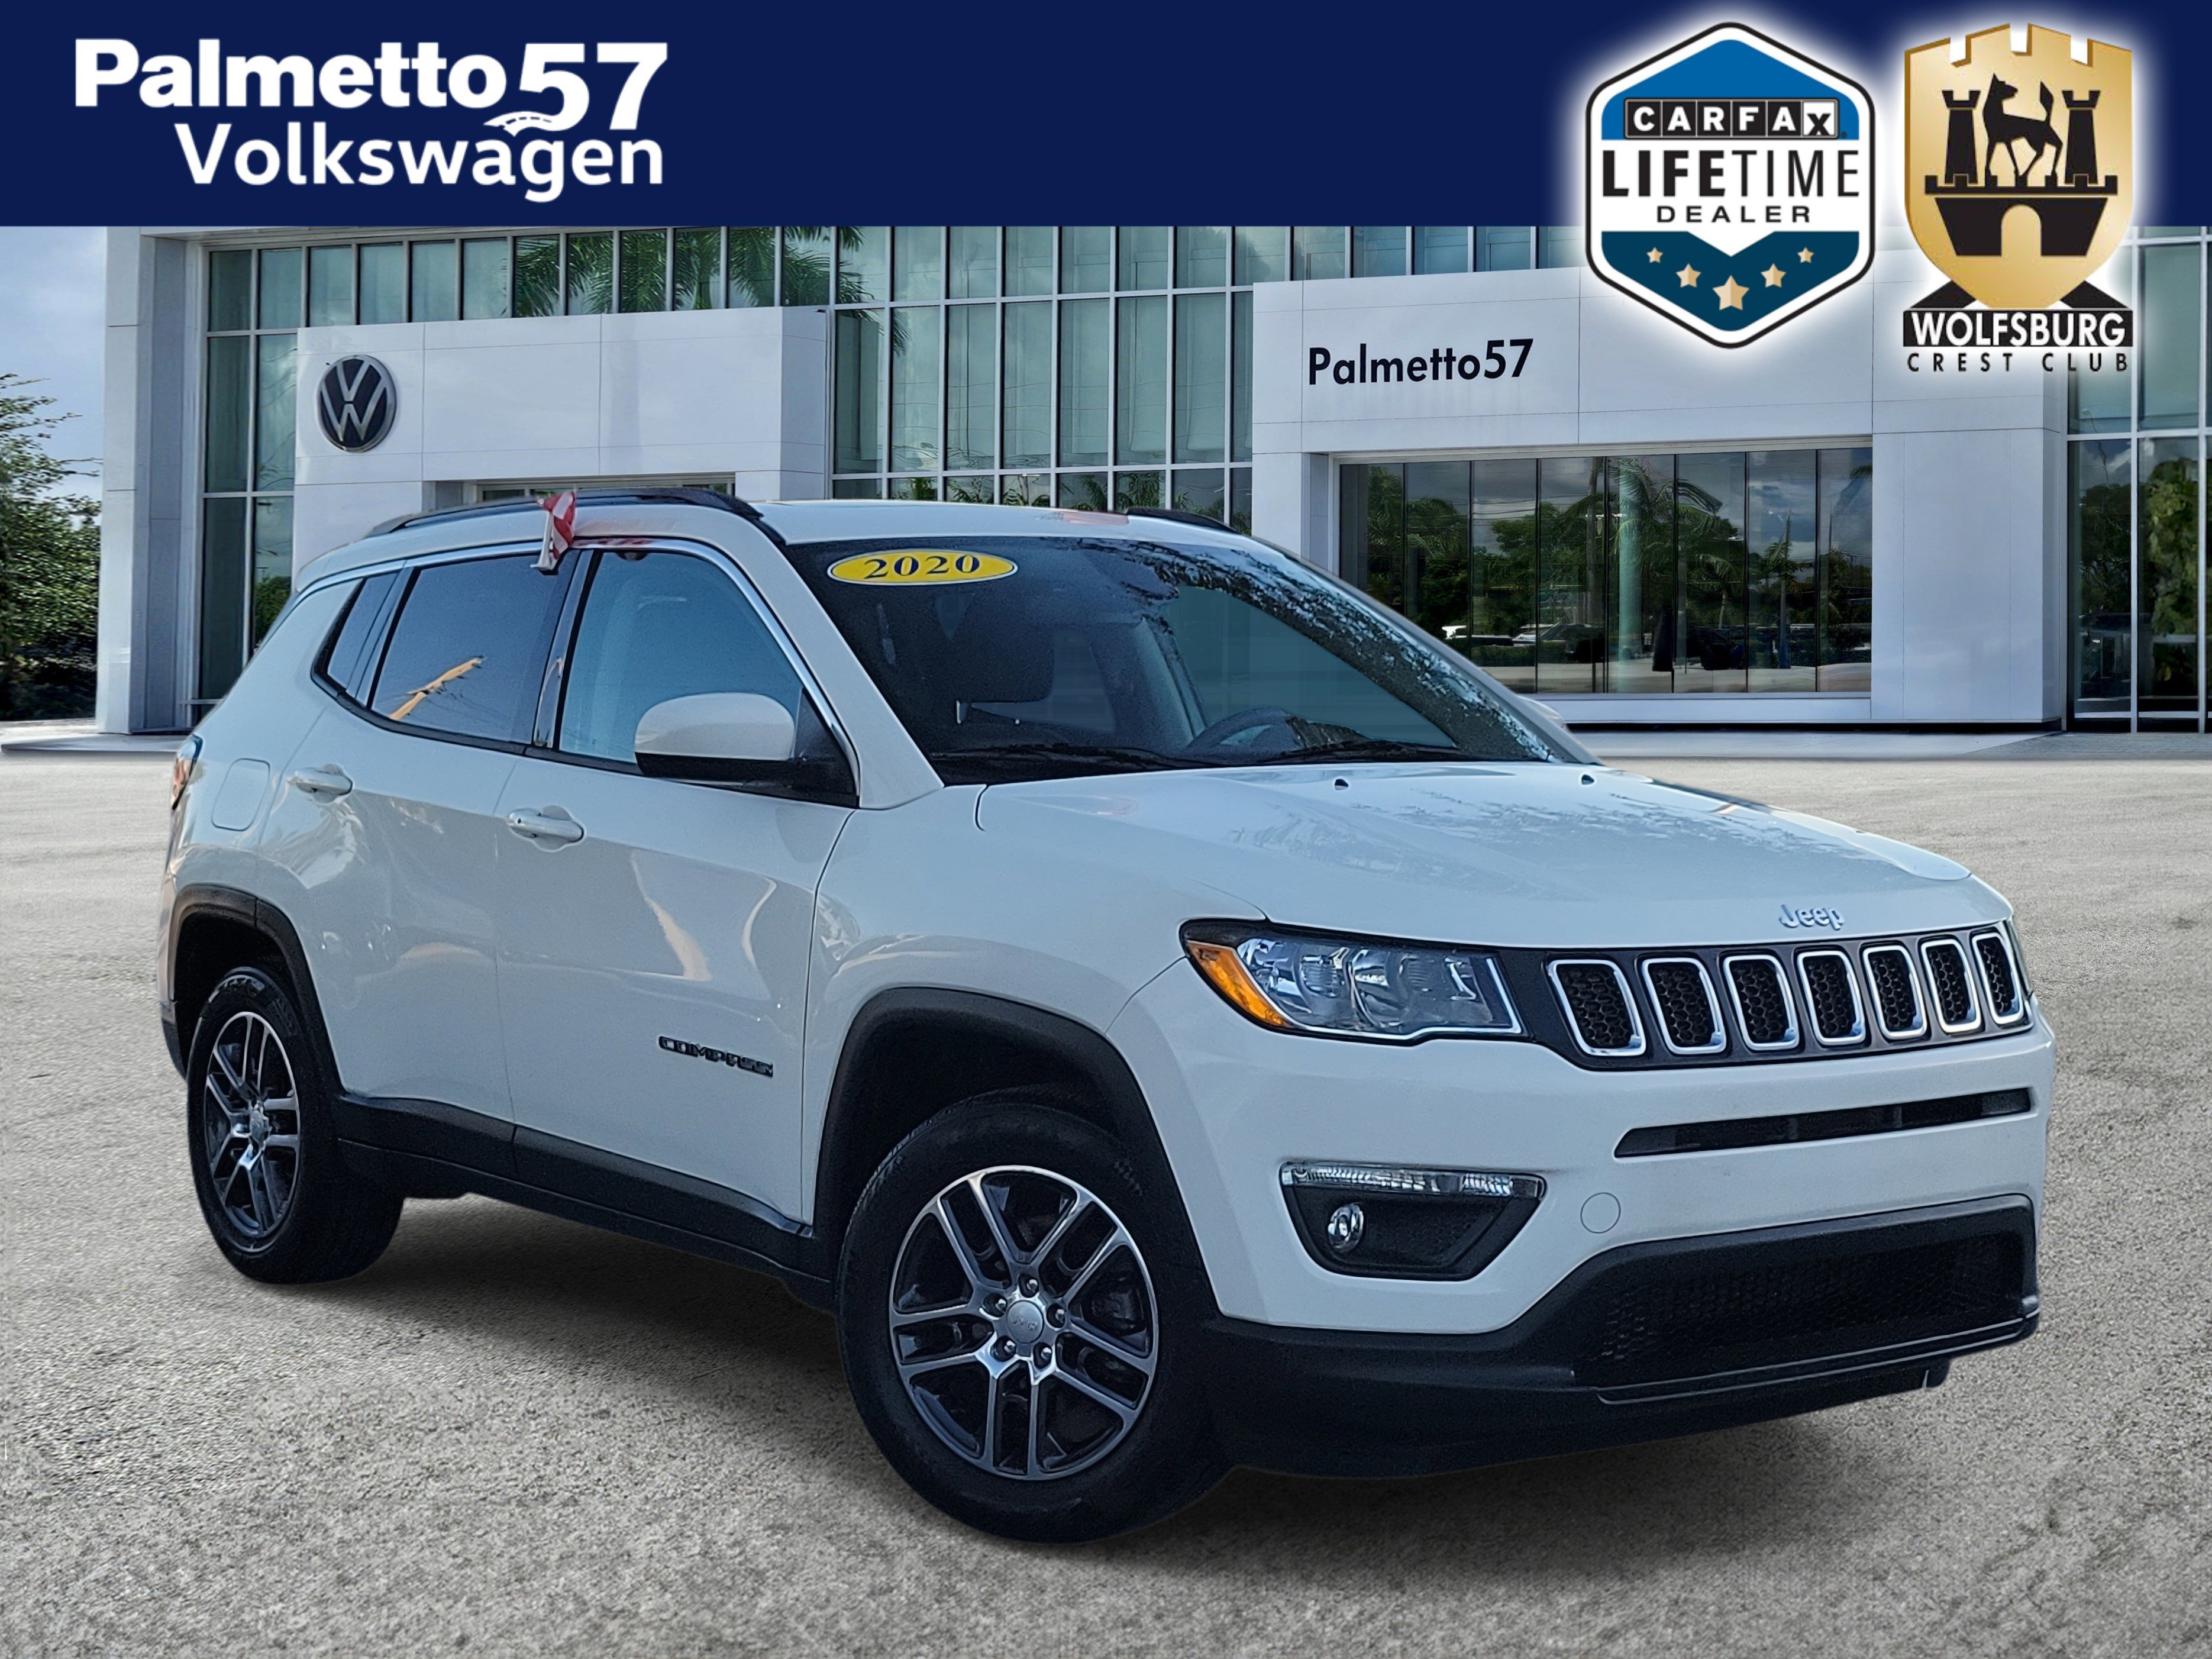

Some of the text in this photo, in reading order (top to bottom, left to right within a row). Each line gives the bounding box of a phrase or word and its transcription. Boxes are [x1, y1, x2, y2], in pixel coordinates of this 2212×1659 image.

[1309, 338, 1533, 385] Palmetto57
[864, 555, 980, 579] 2020
[1779, 904, 1845, 931] Jeep
[658, 1036, 773, 1078] COMPASS
